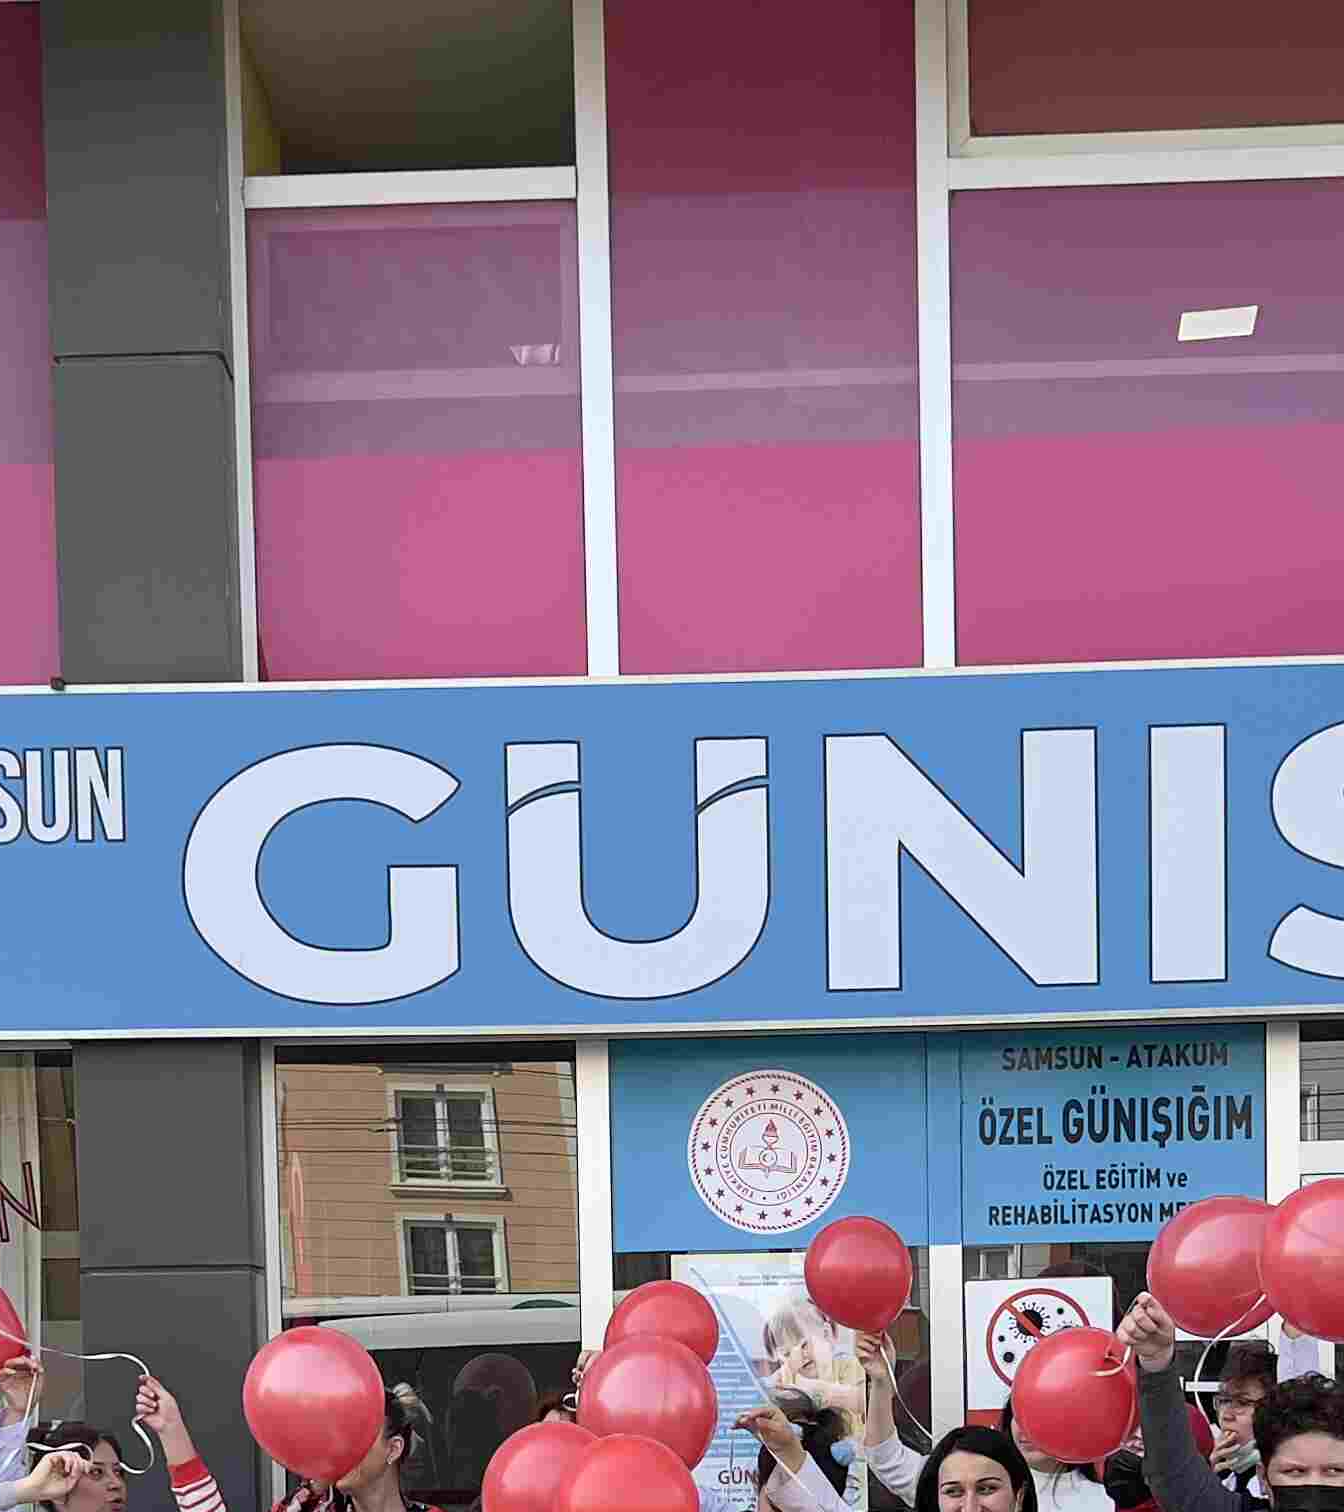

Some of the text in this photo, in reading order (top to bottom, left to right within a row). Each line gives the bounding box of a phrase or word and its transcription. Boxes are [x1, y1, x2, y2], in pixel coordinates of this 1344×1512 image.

[1002, 1045, 1103, 1071] SAMSUN
[1126, 1041, 1229, 1069] ATAKUM
[978, 1084, 1254, 1148] ÖZEL GÜNIŞIĞIM
[1042, 1162, 1188, 1191] ÖZEL EĞİTİM ve
[988, 1198, 1153, 1227] REHABİLİTASYON
